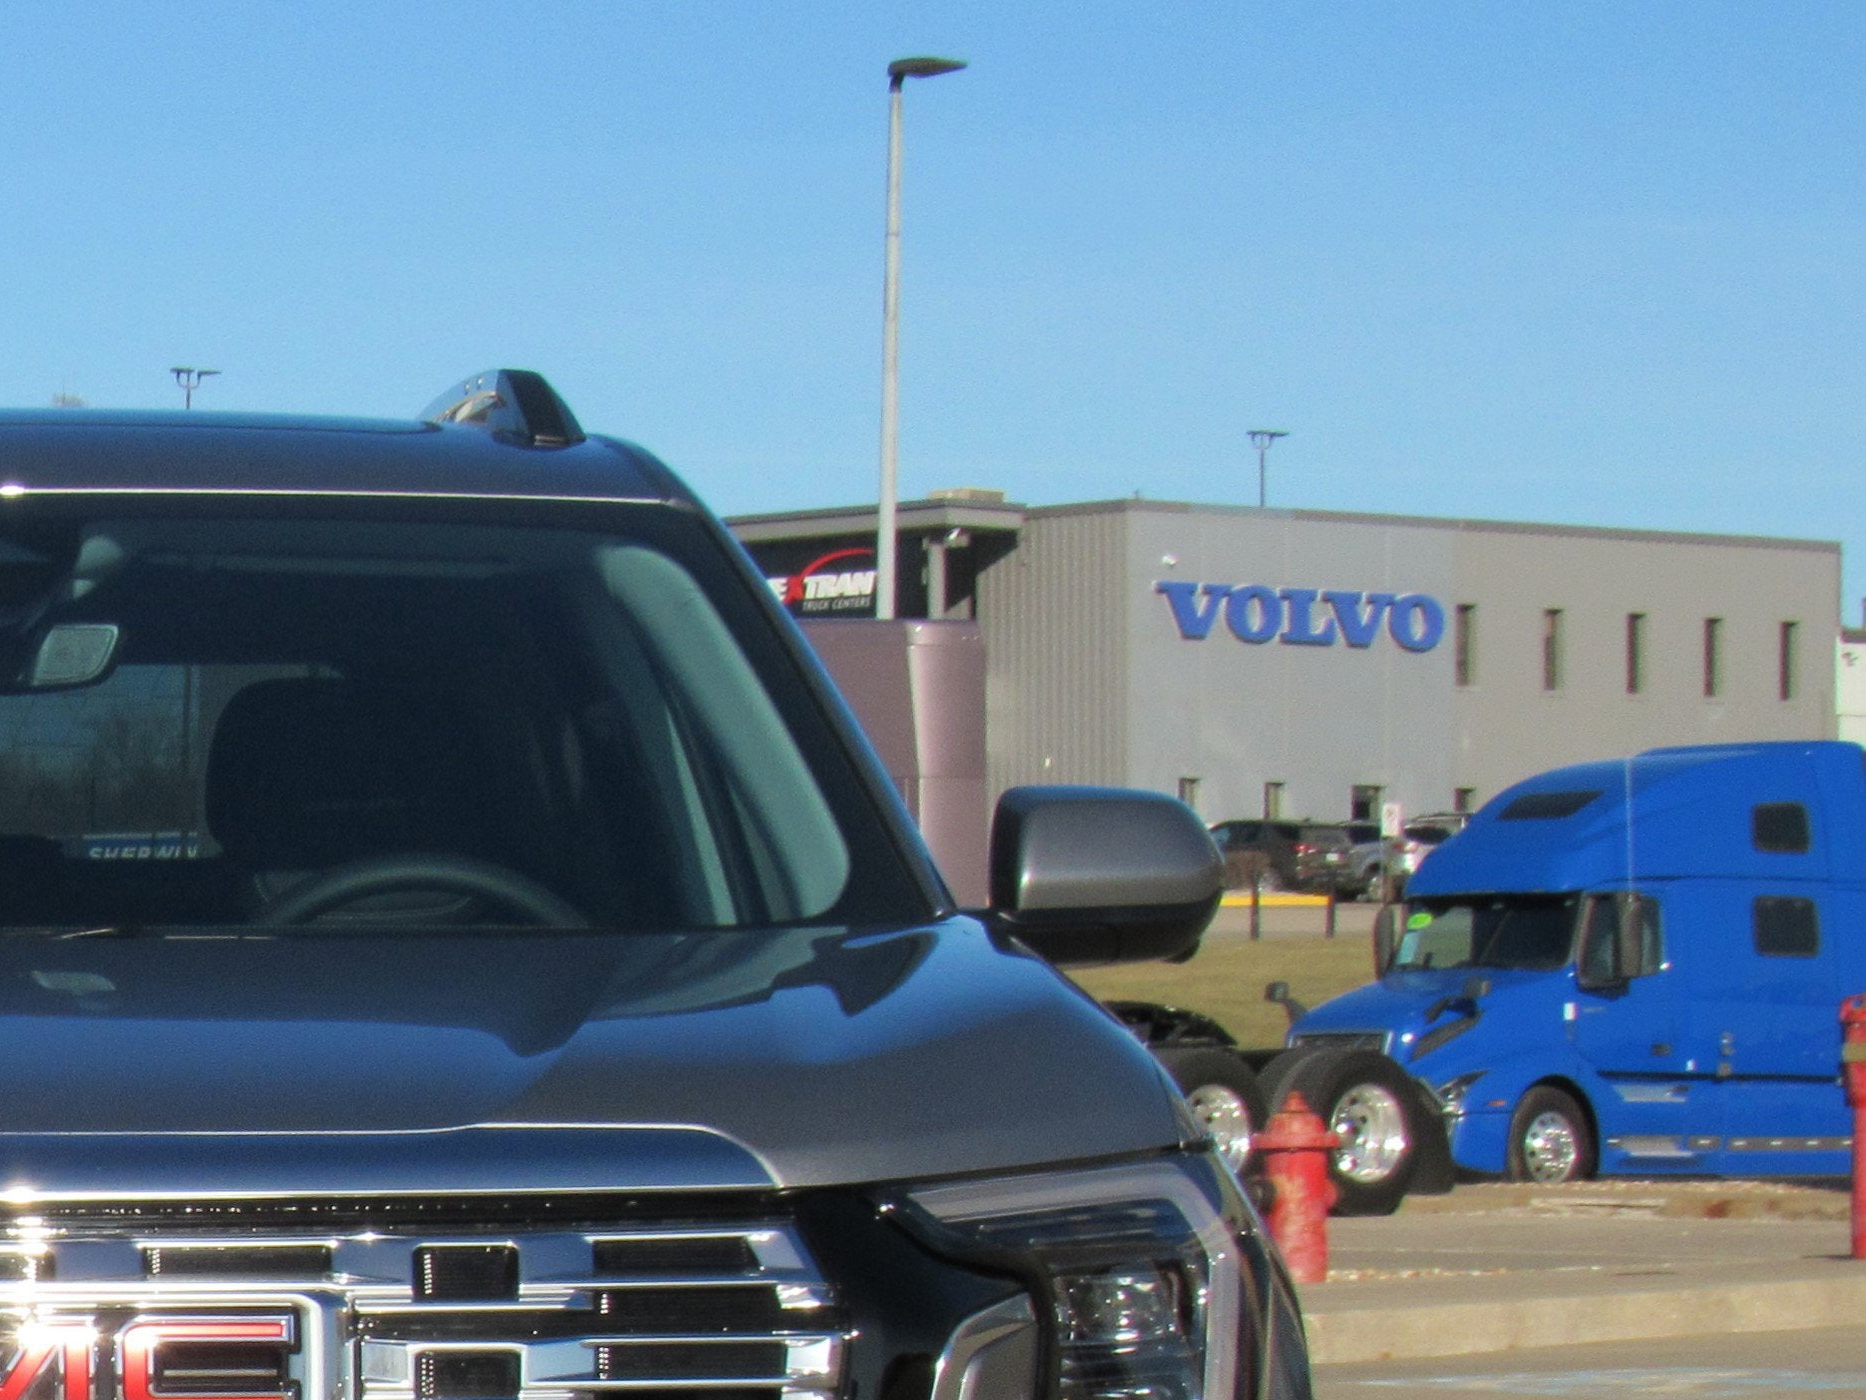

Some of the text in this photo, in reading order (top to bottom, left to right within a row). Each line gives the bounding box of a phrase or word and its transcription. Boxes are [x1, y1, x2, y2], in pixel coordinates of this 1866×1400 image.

[767, 571, 877, 605] EXTRAN
[802, 600, 829, 612] TRUCK
[1152, 579, 1446, 653] VOLVO
